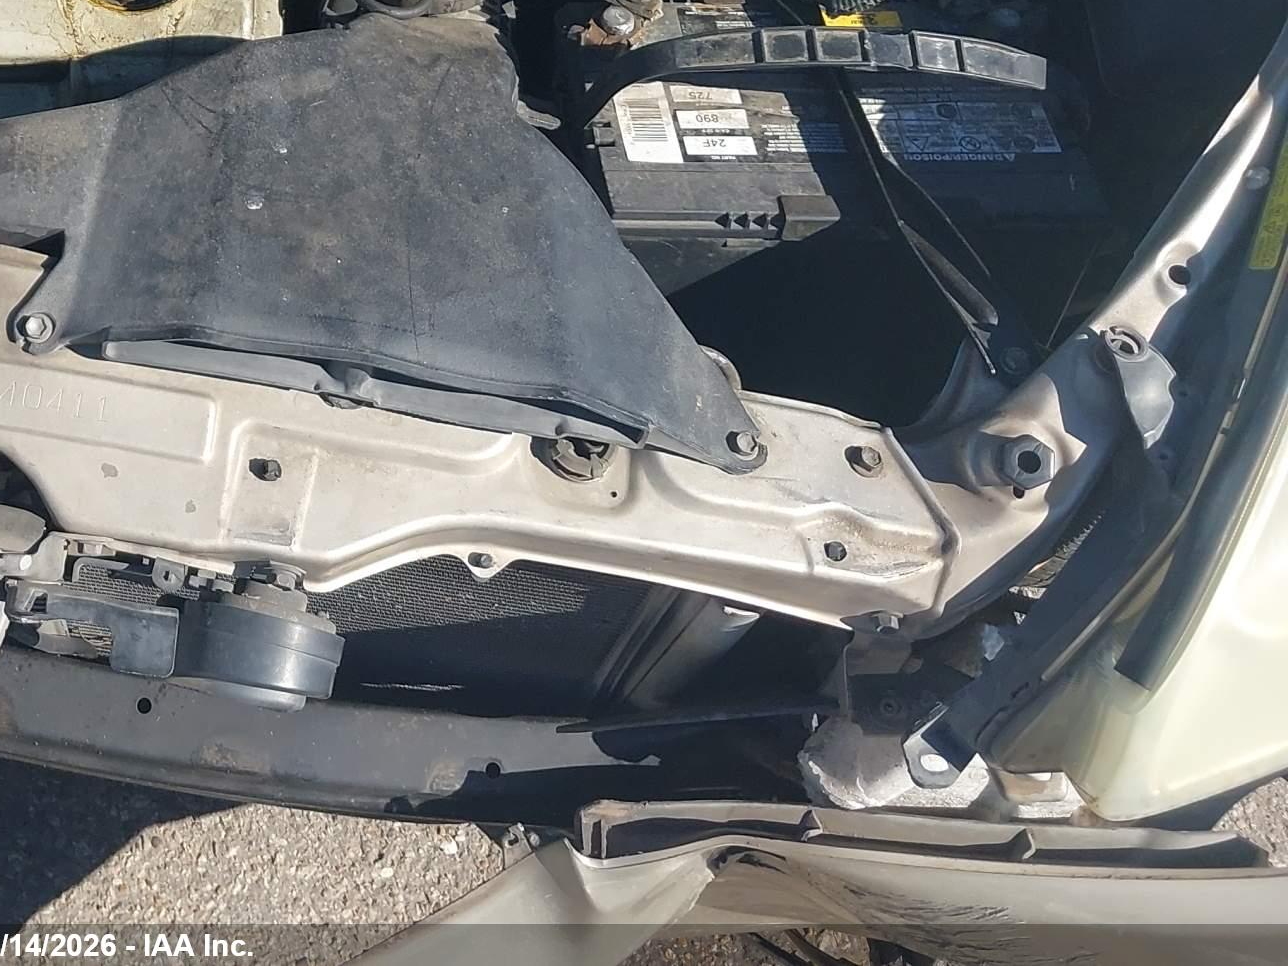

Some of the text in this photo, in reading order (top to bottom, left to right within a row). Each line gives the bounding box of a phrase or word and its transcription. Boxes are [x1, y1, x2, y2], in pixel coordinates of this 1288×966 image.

[688, 91, 713, 100] 725
[696, 114, 719, 123] 890
[703, 138, 727, 148] 24F
